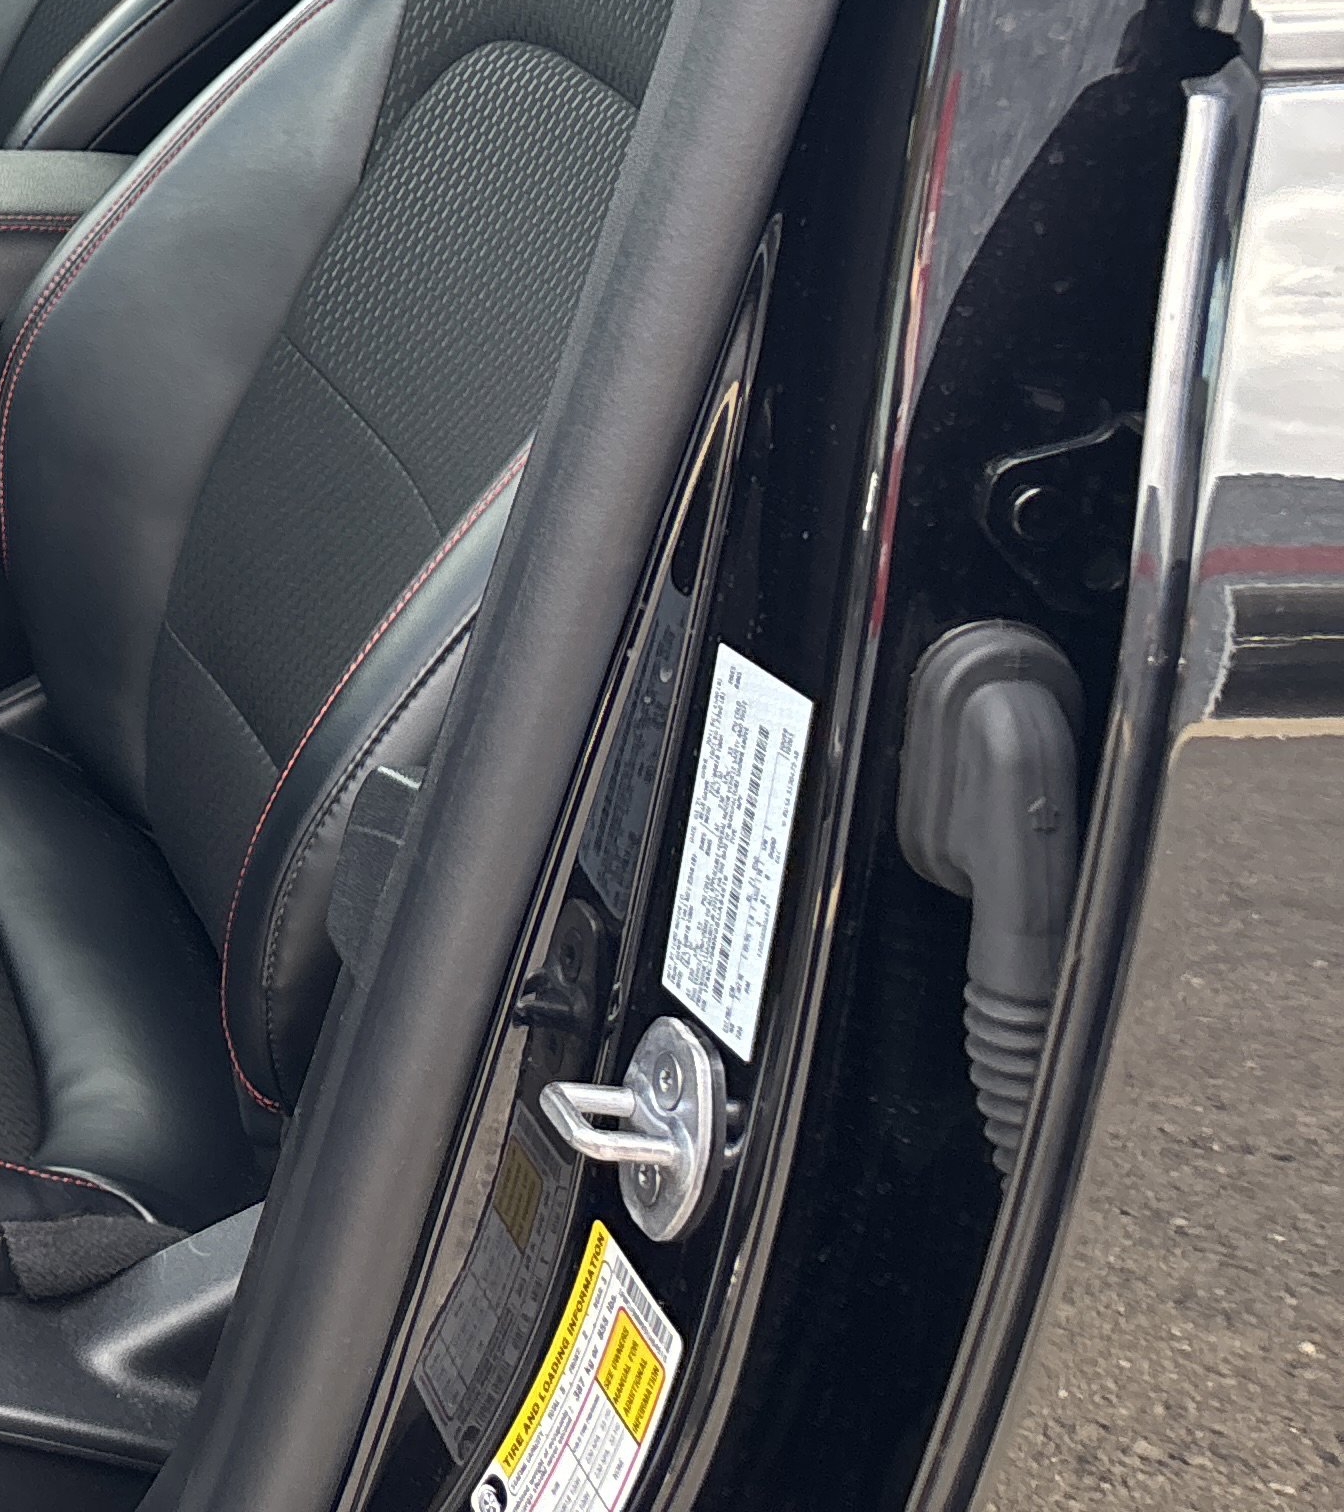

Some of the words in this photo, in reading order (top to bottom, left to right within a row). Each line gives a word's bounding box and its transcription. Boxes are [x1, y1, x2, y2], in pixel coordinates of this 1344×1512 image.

[502, 1432, 525, 1468] TIRE
[523, 1402, 540, 1435] AND
[538, 1337, 570, 1403] LOADING
[566, 1231, 605, 1337] INFORMATION
